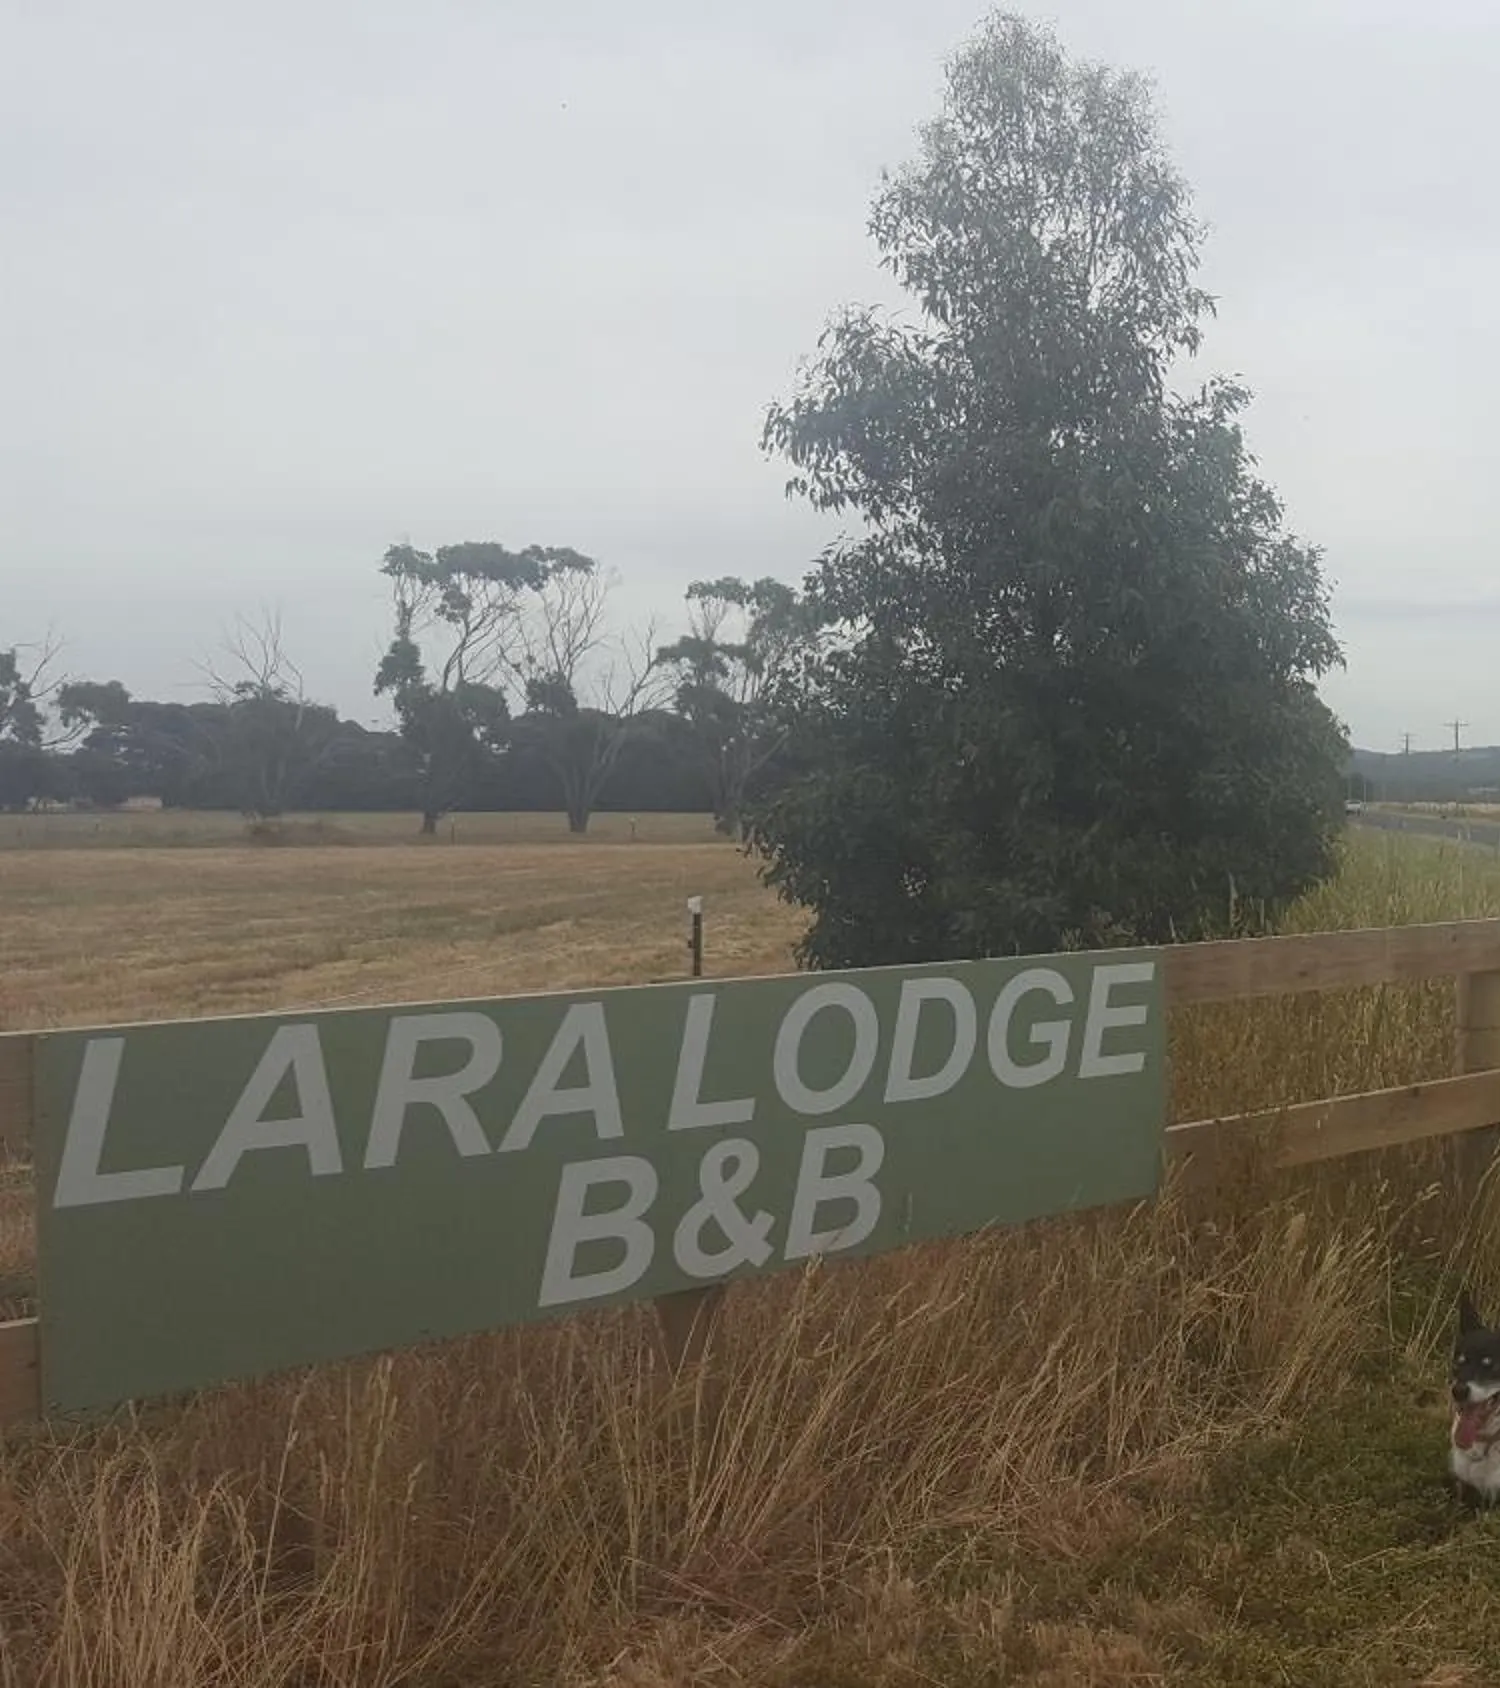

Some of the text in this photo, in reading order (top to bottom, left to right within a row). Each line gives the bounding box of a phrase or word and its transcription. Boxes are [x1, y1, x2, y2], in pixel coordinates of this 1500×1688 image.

[53, 961, 1155, 1208] LARA LODGE
[538, 1123, 885, 1307] B&B
